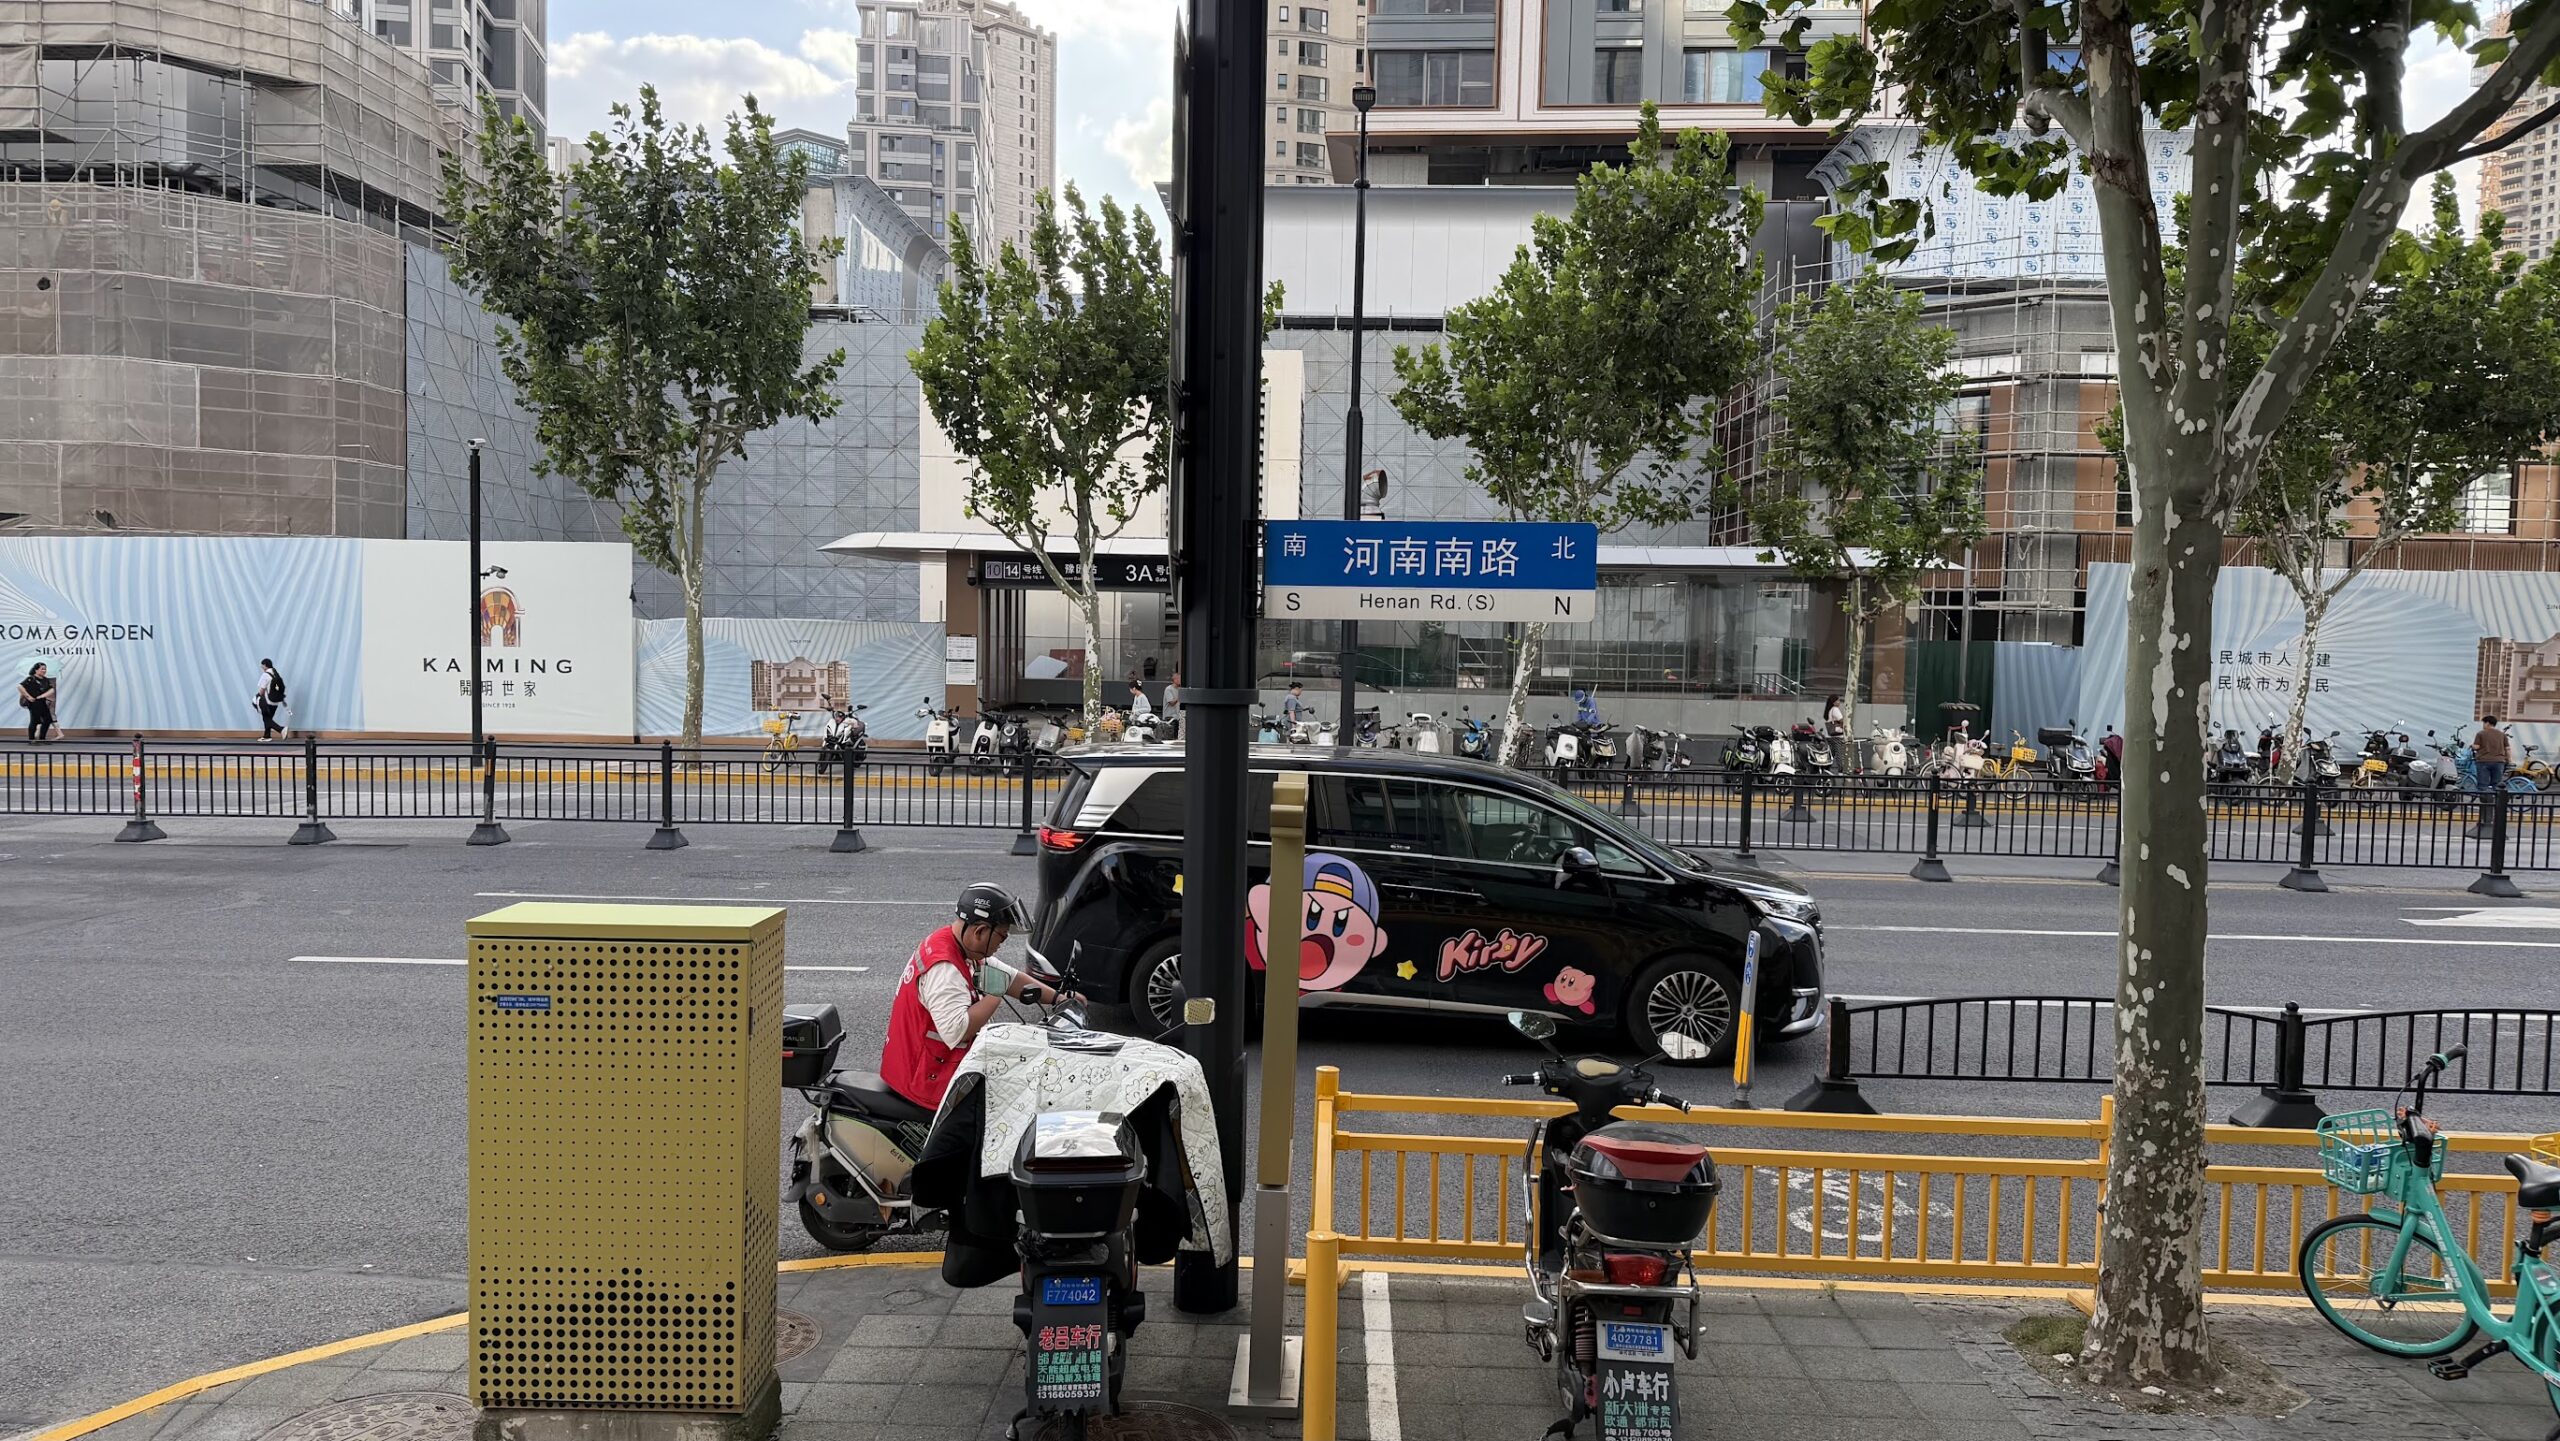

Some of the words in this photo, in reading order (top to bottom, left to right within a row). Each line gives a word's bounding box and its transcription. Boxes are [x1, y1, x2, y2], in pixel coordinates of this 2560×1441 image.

[1283, 532, 1307, 557] 南
[1342, 536, 1520, 577] 河南南路
[1551, 535, 1576, 560] 北
[986, 564, 1001, 576] 10
[1005, 564, 1019, 577] 14
[1022, 564, 1042, 575] 号线
[1126, 564, 1153, 581] 3A
[1286, 592, 1301, 611] S
[1360, 593, 1420, 610] Henan
[1431, 593, 1496, 612] Rd.(S)
[1554, 596, 1571, 616] N
[64, 624, 154, 640] GARDEN
[35, 647, 96, 655] SHANGHAI
[2210, 650, 2331, 668] 民城市人建
[423, 658, 573, 674] KAMING
[459, 679, 536, 697] 開明世家
[2218, 675, 2330, 693] 民城市为民
[1438, 929, 1546, 980] Kirby
[1047, 1289, 1096, 1302] F774042
[1039, 1324, 1102, 1350] 老吕车行
[1611, 1333, 1658, 1345] 4027781
[1602, 1369, 1670, 1401] 小卢车行
[1036, 1390, 1102, 1399] 13166059397
[1604, 1401, 1649, 1416] 新大洲
[1650, 1405, 1671, 1416] 专卖
[1635, 1416, 1672, 1429] 都市风
